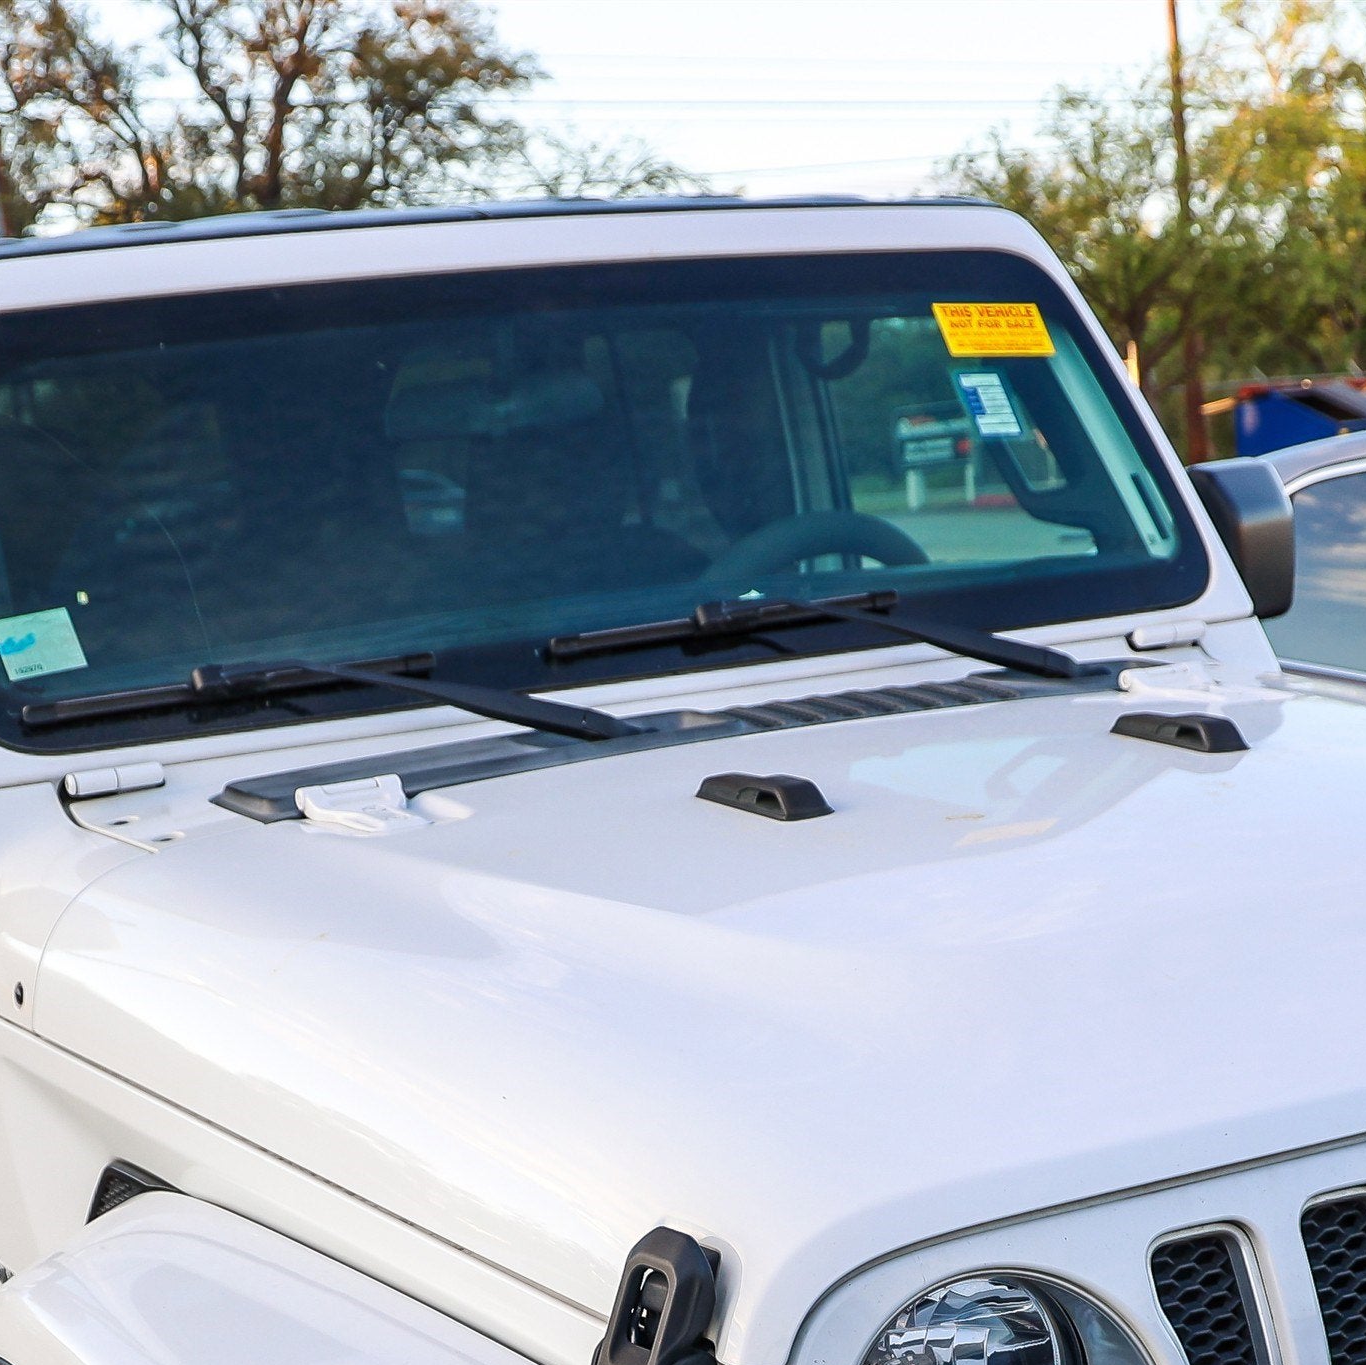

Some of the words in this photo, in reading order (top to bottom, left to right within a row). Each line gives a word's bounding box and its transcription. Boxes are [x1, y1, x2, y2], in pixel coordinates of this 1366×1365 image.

[939, 306, 972, 317] THIS
[975, 306, 1035, 317] VEHICLE
[950, 320, 973, 328] NOT
[977, 320, 1002, 328] FOR
[1006, 320, 1037, 328] SALE
